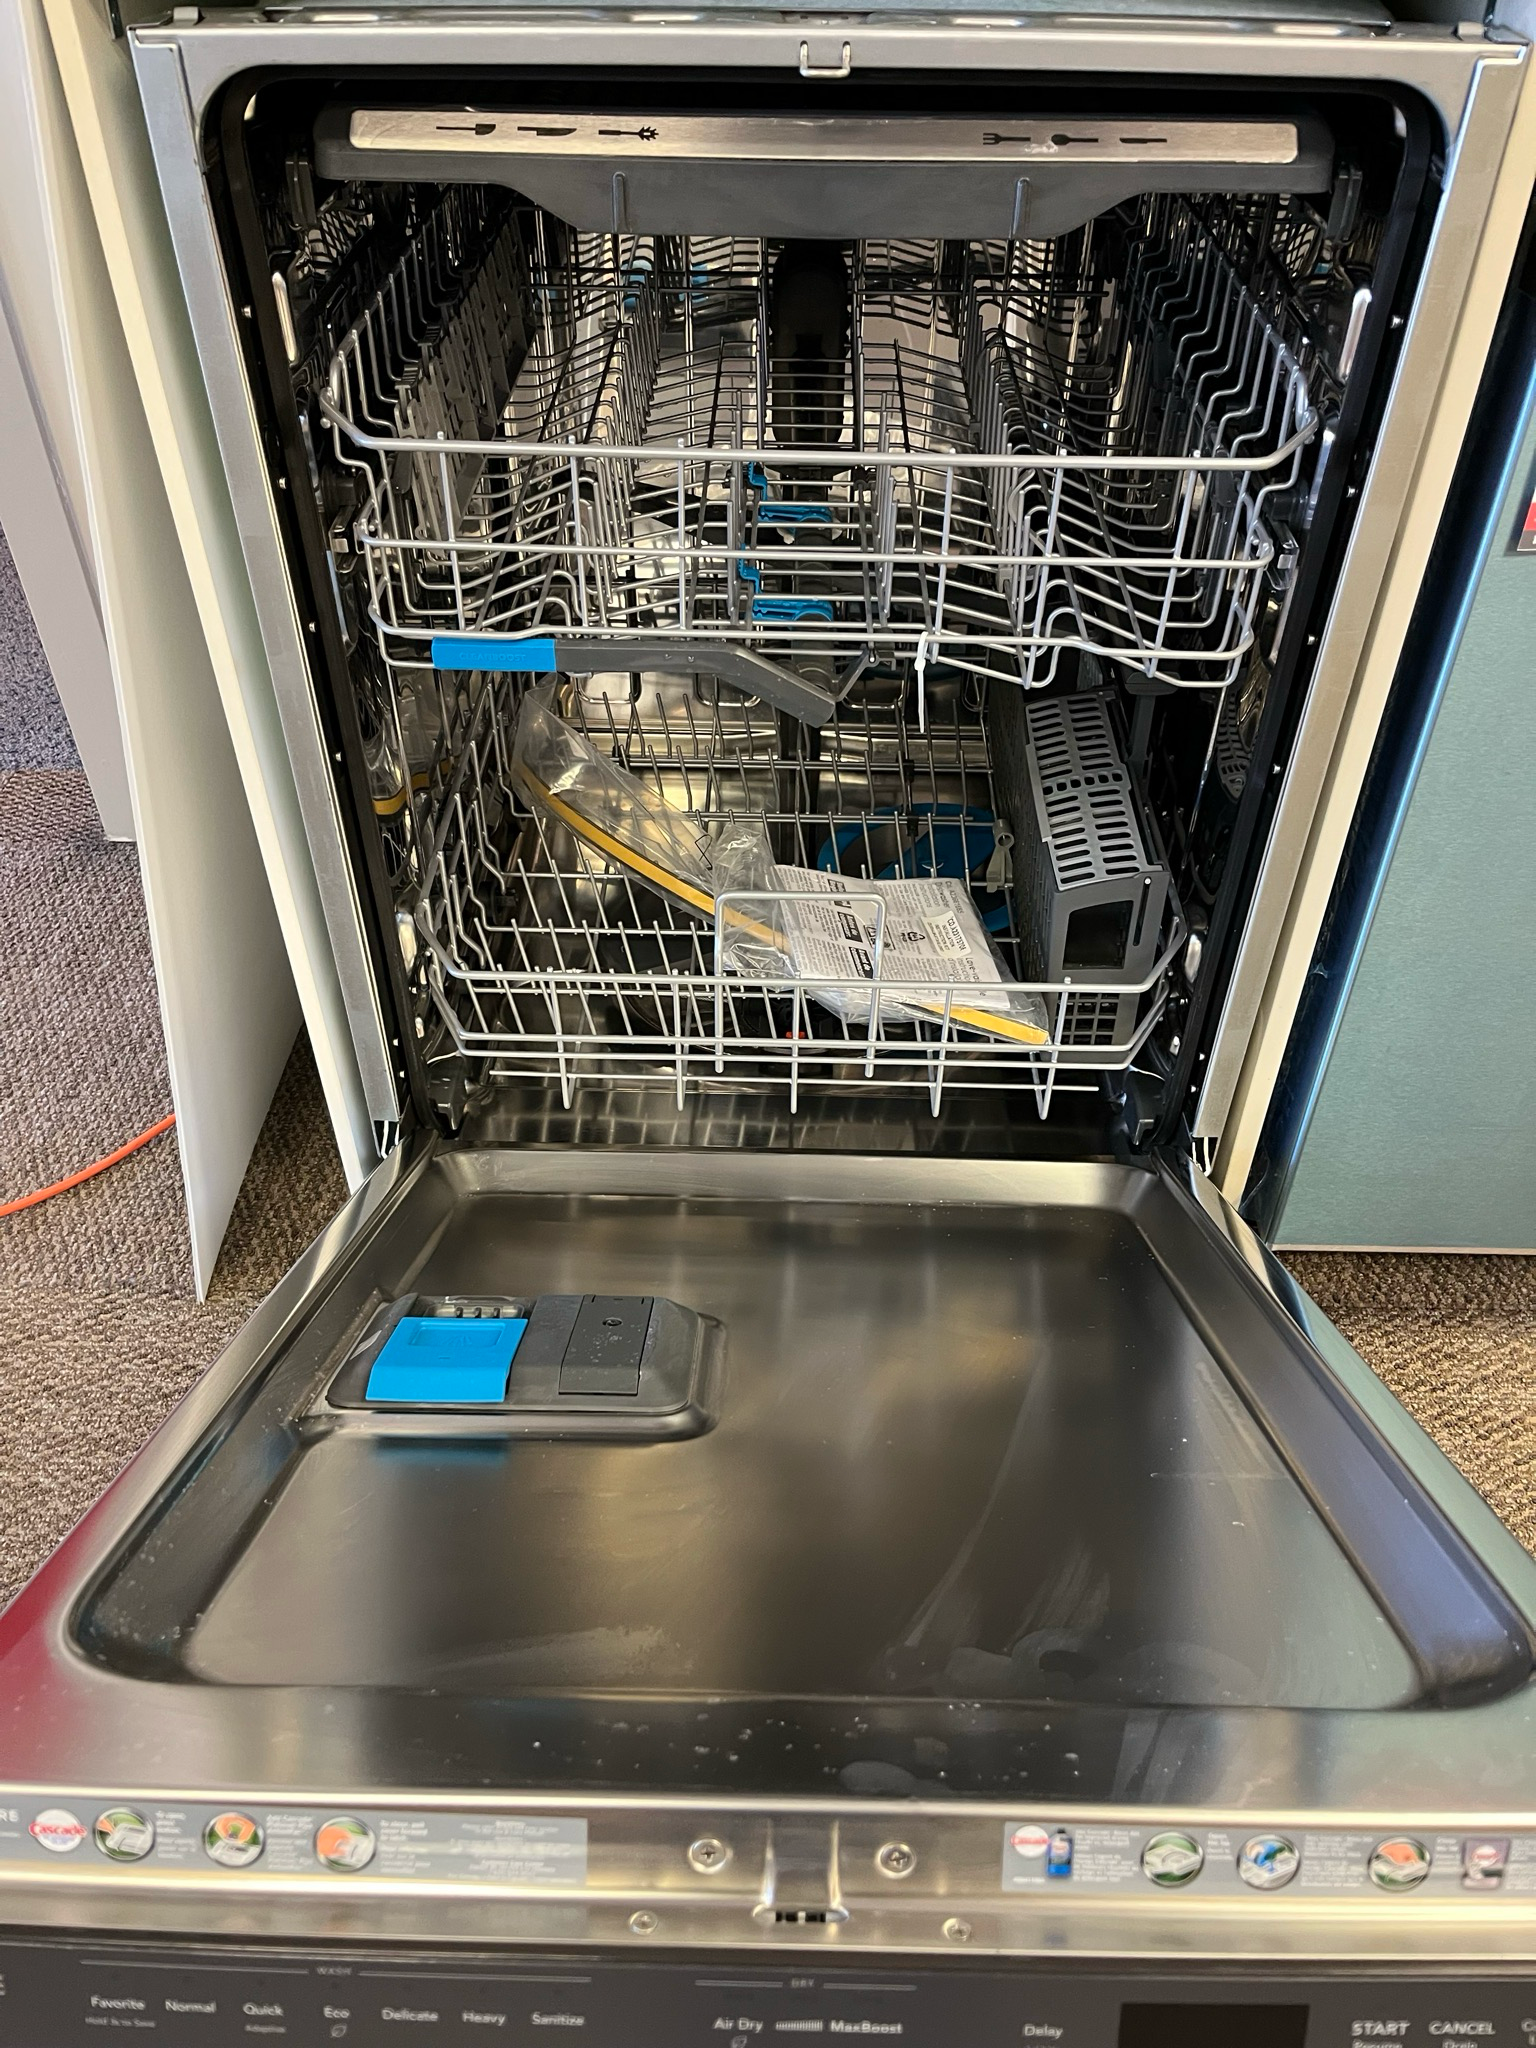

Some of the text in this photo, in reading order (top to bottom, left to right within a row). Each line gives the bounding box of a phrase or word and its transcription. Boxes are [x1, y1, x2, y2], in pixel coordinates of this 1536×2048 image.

[28, 1821, 87, 1838] Cascade
[317, 1967, 351, 1976] WASH
[90, 1995, 146, 2011] Favorite
[164, 1998, 216, 2014] Normal
[243, 2002, 284, 2017] Quick
[323, 2005, 350, 2019] Eco
[380, 2007, 439, 2023] Delicate
[462, 2011, 506, 2027] Heavy
[530, 2012, 585, 2027] Sanitize
[714, 2017, 763, 2034] Air Dry
[828, 2020, 903, 2035] MaxBoost
[1023, 2023, 1064, 2040] Delay
[1351, 2020, 1411, 2036] START
[1428, 2020, 1496, 2036] CANCEL
